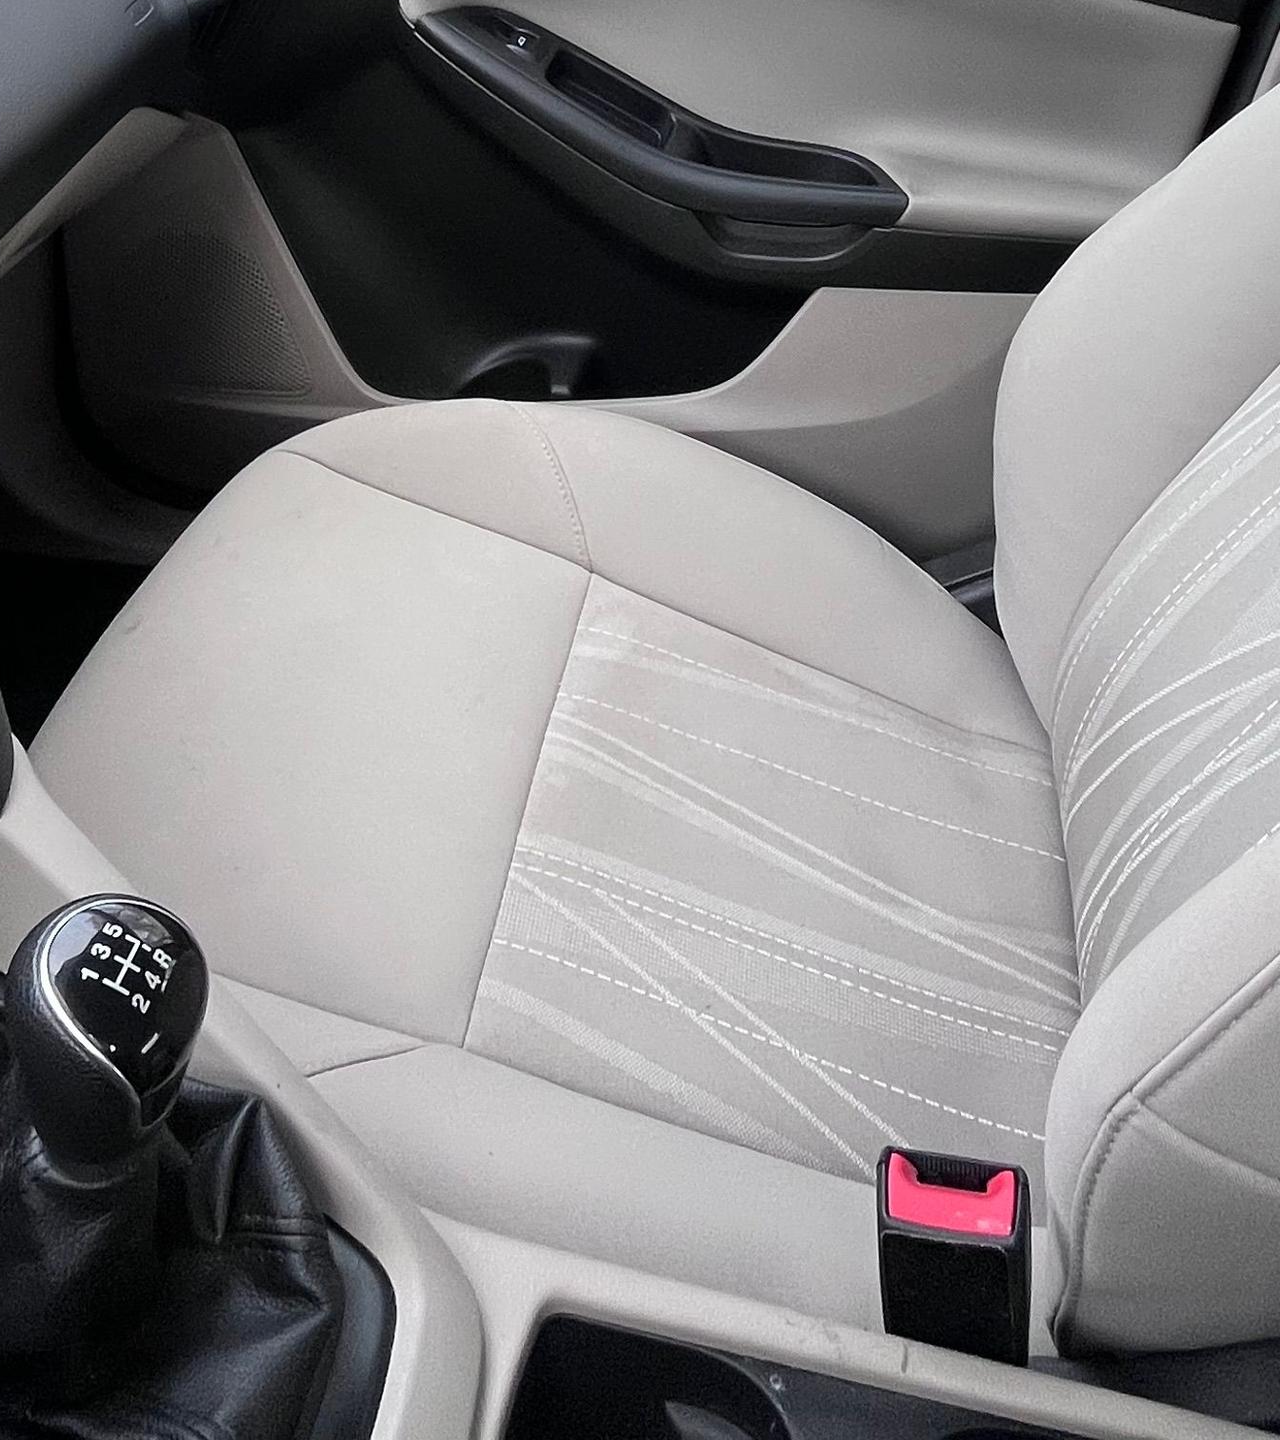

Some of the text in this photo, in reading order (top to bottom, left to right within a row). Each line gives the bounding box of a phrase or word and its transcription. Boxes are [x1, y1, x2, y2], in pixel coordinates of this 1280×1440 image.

[80, 921, 124, 981] 1 3 5
[131, 948, 173, 1014] 2 4 R
